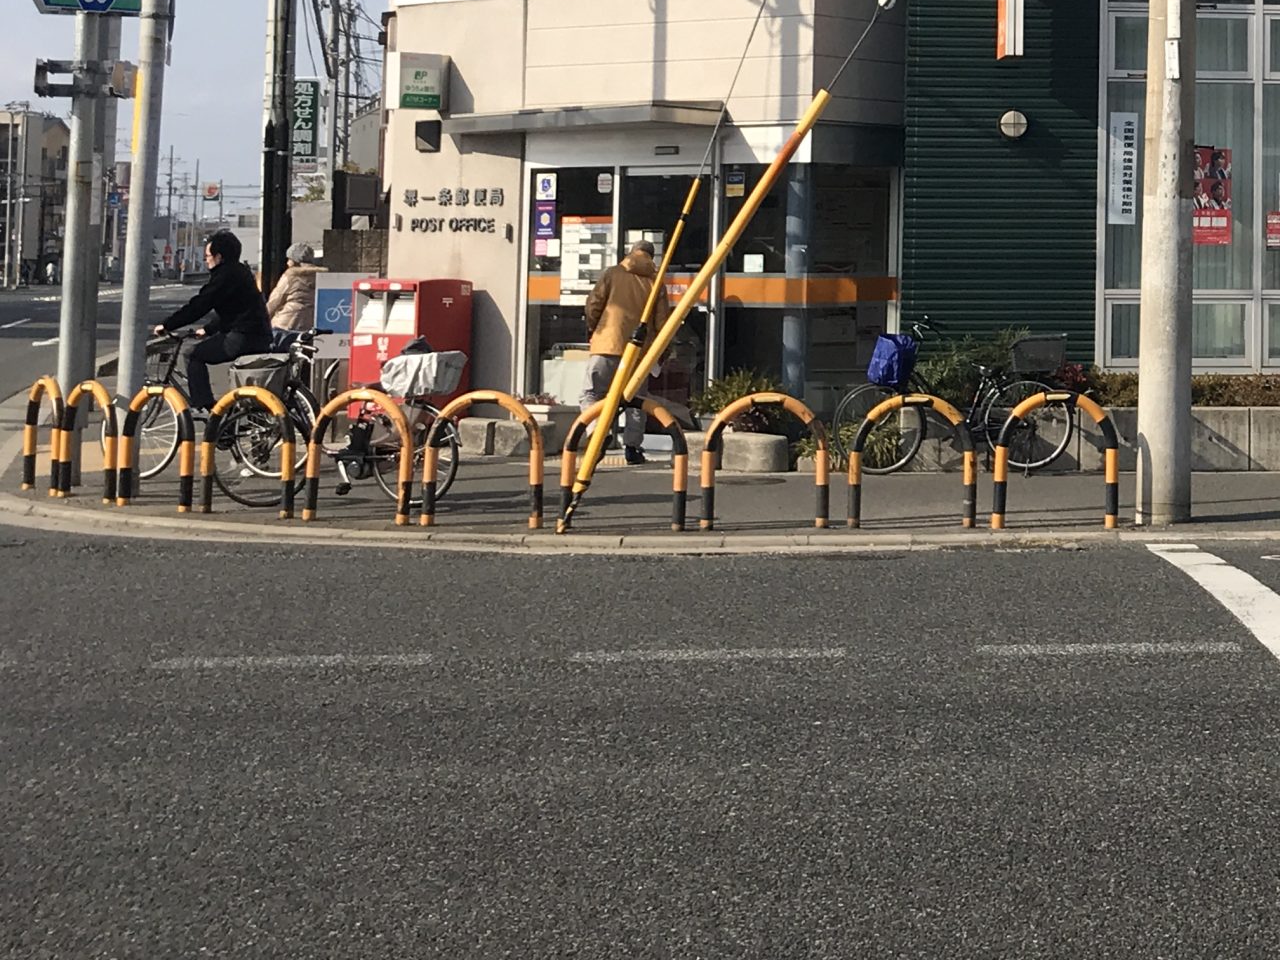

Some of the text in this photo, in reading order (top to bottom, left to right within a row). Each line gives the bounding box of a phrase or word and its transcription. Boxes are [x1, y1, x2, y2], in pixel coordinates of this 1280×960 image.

[292, 82, 314, 155] 処方せん調剤
[403, 187, 504, 208] 堺一条郵便局
[411, 217, 496, 234] POST OFFICE
